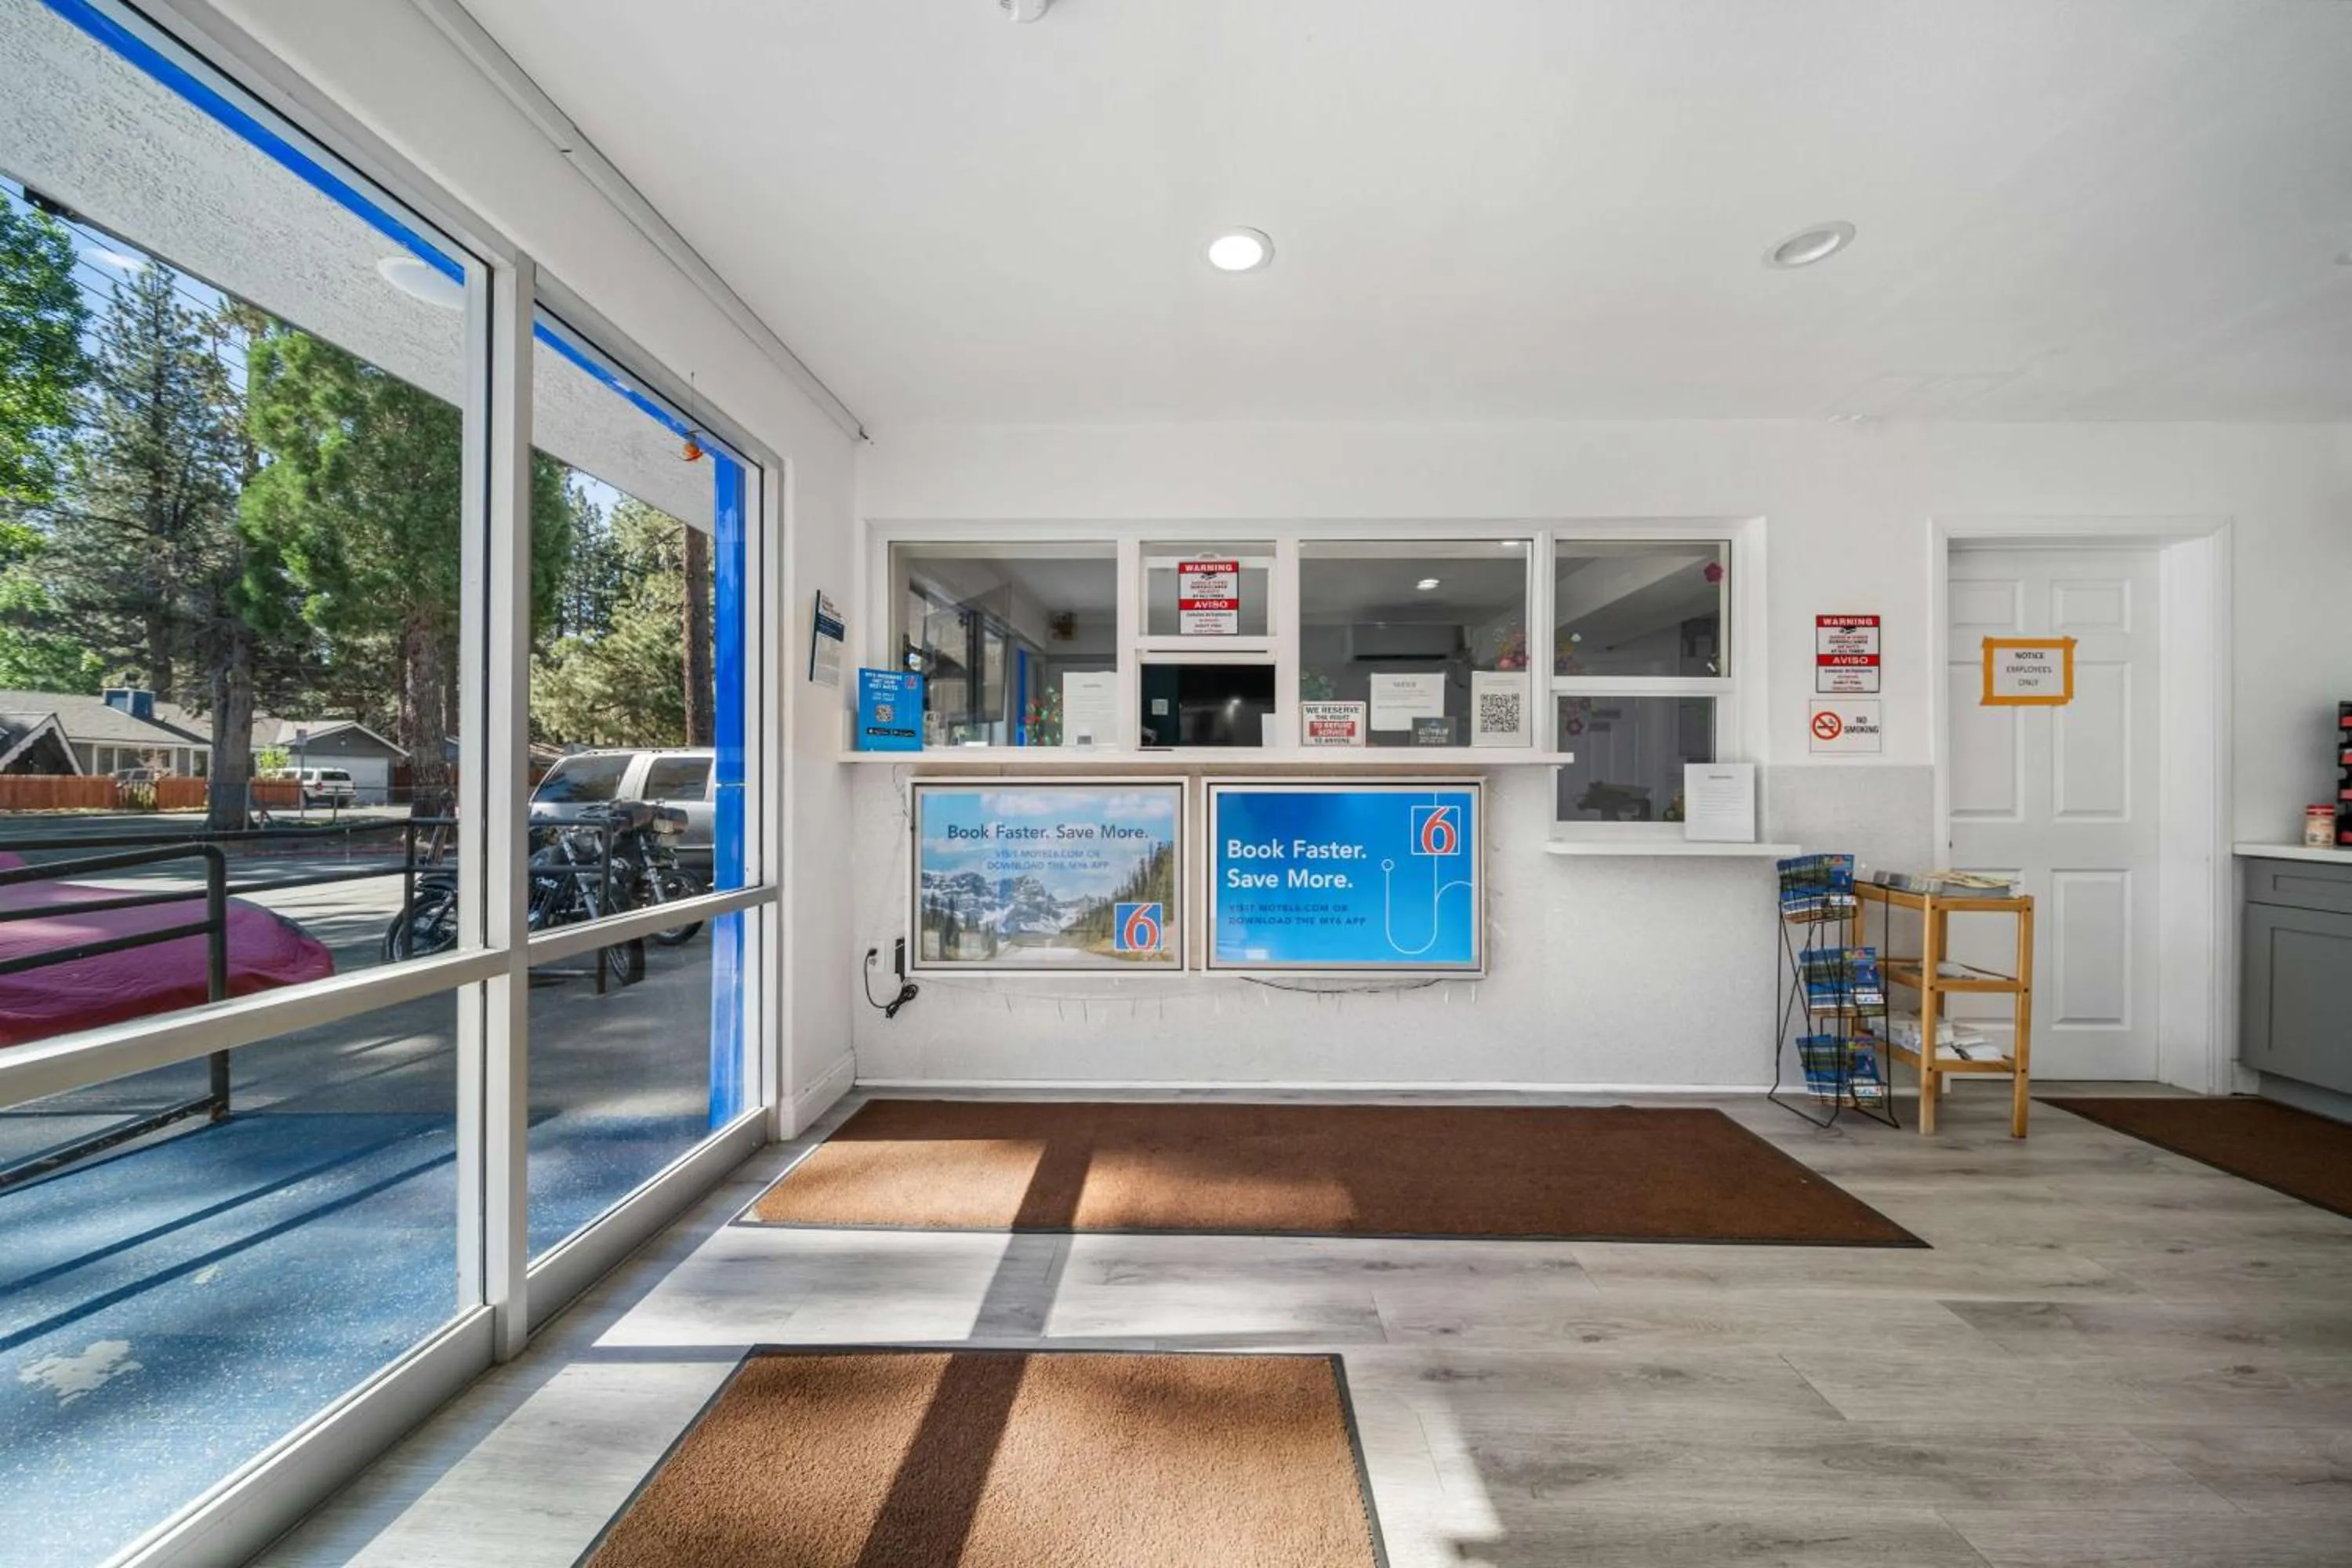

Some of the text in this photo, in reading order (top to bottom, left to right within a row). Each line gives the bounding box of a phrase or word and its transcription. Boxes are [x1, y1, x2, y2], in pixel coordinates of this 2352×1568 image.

[1193, 600, 1229, 609] AVISO
[1823, 617, 1873, 626] WARNING
[1831, 656, 1869, 665] AVISO
[1856, 715, 1867, 724] NO
[1844, 725, 1879, 734] SMOKING
[947, 824, 1149, 840] Book Faster. Save More.
[1421, 807, 1457, 855] 6
[1227, 839, 1367, 860] Book Faster.
[1227, 868, 1353, 889] Save More.
[1229, 904, 1348, 913] VISIT MOTEL6.COM OR
[1229, 916, 1367, 926] DOWNLOAD THE MY6 APP
[1124, 904, 1160, 951] 6
